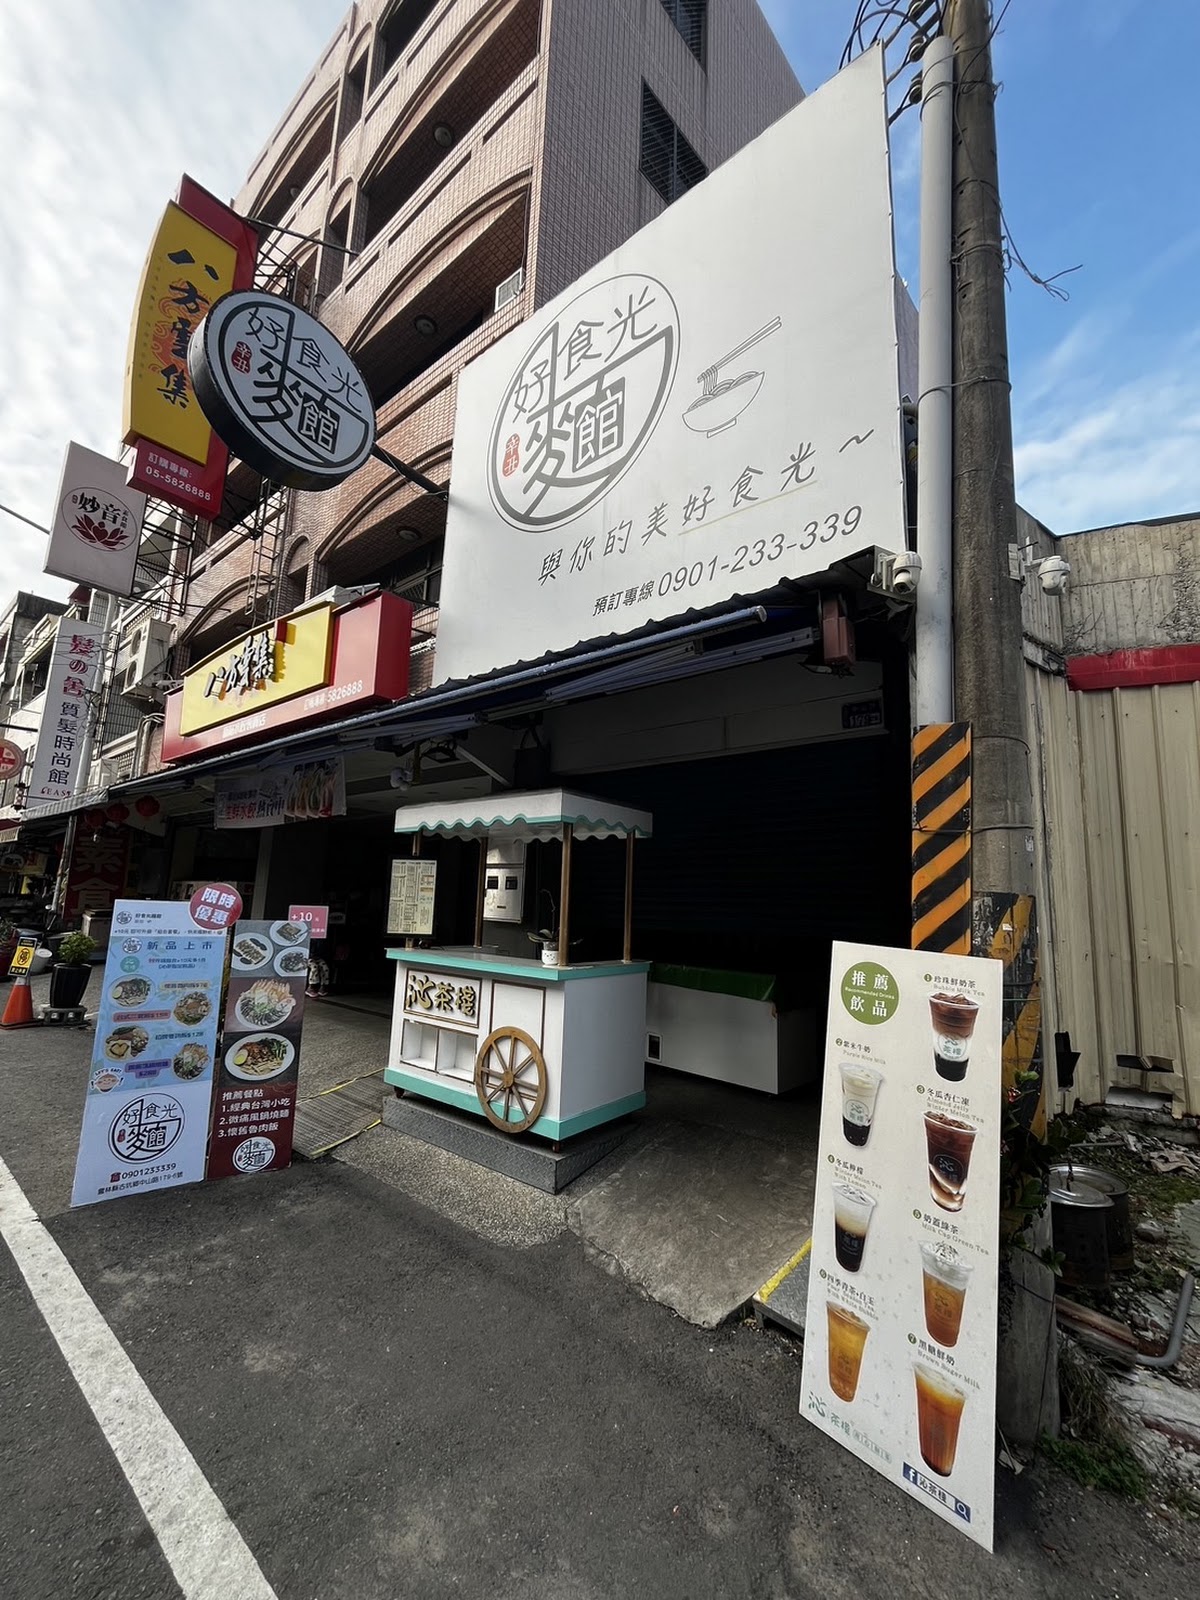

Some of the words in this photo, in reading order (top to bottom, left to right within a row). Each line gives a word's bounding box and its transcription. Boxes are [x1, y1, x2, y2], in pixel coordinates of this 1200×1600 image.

[157, 249, 219, 409] 八方雲集
[146, 466, 211, 501] 05-5826888
[593, 579, 654, 616] 預訂專線
[659, 506, 862, 597] 0901-233-339
[201, 888, 236, 908] 限時
[195, 905, 230, 925] 優惠
[147, 941, 213, 951] 新品上市
[852, 970, 889, 991] 推薦
[407, 974, 477, 1017] 沁茶棧
[850, 995, 887, 1017] 飲品
[121, 1163, 177, 1179] 0901233339
